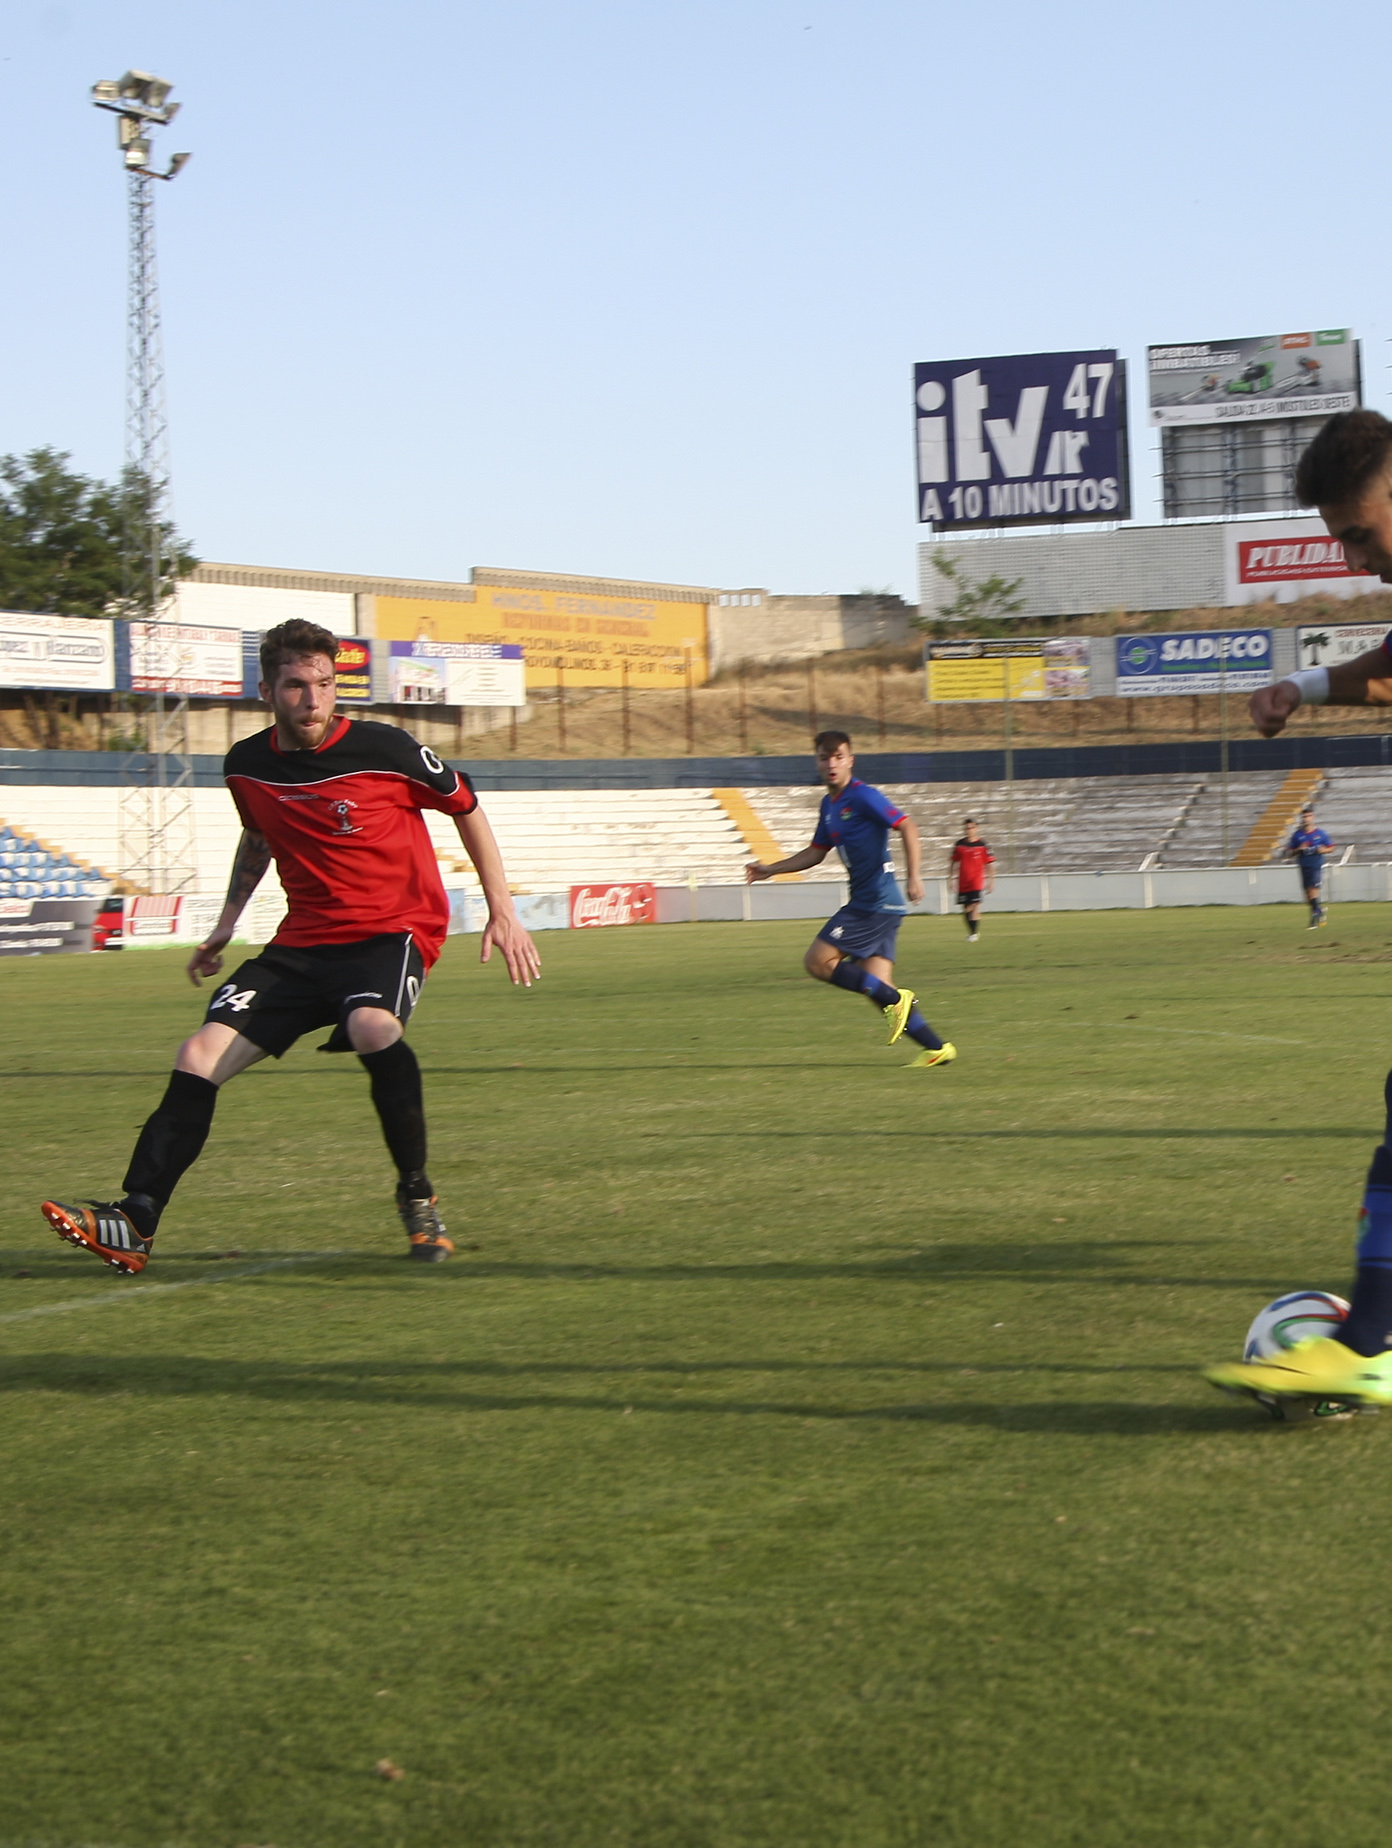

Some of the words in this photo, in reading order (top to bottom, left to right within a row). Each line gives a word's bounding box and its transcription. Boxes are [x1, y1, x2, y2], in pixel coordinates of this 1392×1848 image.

[1063, 362, 1113, 420] 47
[921, 488, 943, 522] A
[949, 485, 983, 520] 10
[989, 477, 1119, 517] MINUTOS
[1159, 635, 1270, 661] SADECO
[210, 983, 257, 1012] 24
